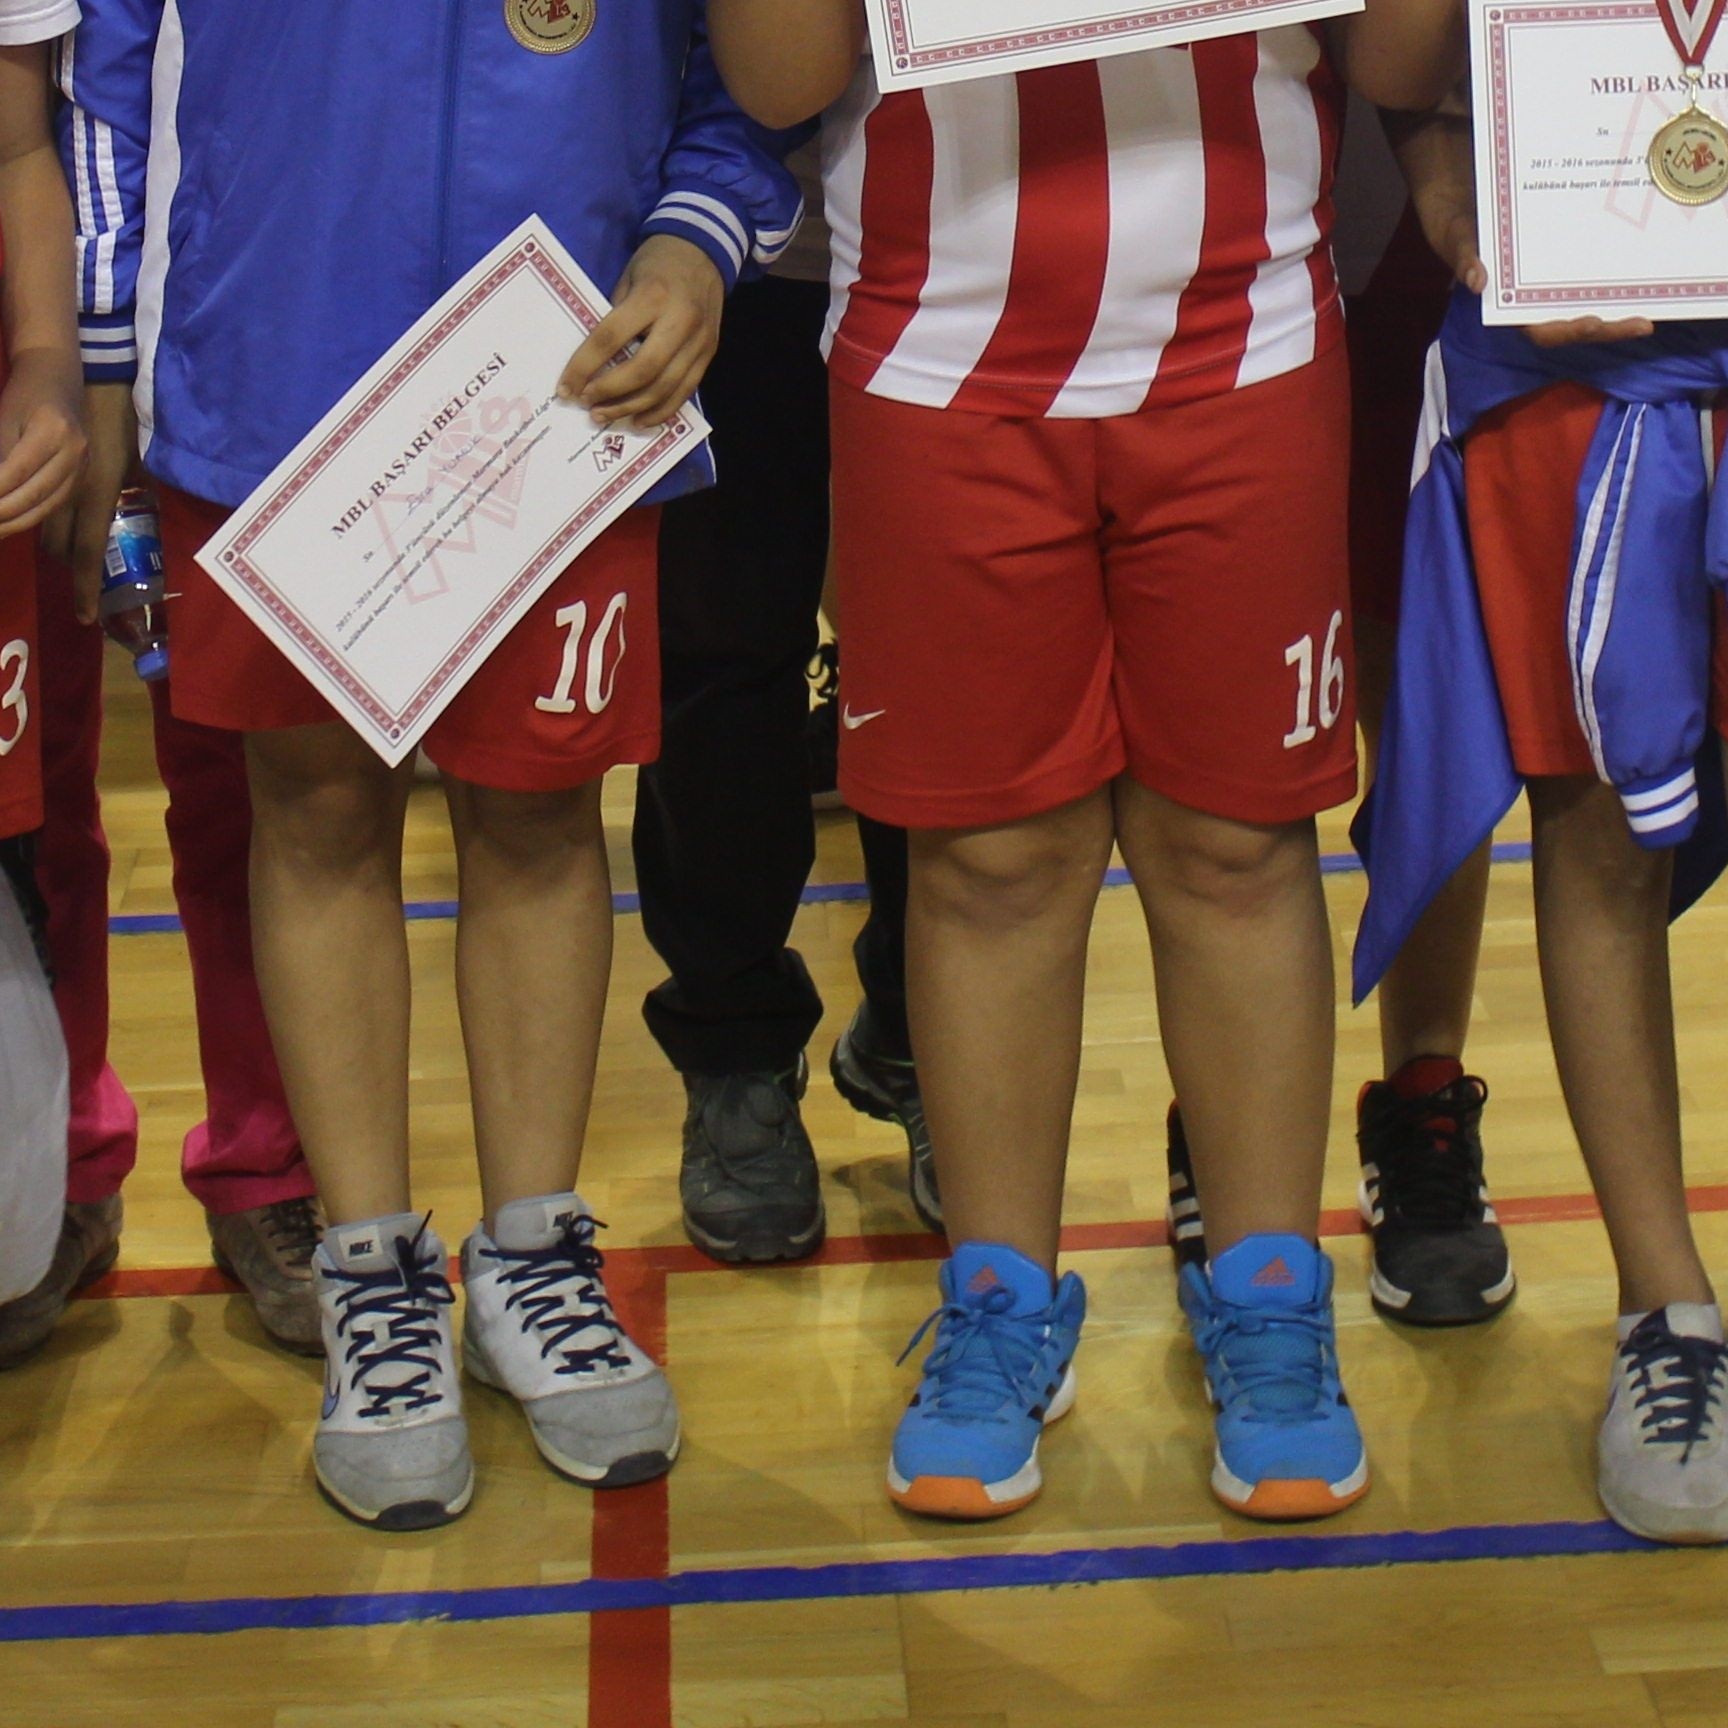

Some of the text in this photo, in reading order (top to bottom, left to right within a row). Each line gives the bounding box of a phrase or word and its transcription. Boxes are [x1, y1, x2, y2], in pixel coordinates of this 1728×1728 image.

[1590, 75, 1643, 96] MBL
[331, 497, 374, 539] MBL
[368, 428, 436, 499] BAŞARI
[432, 352, 508, 432] BELGESİ
[533, 591, 628, 715] 10
[1282, 608, 1345, 751] 16
